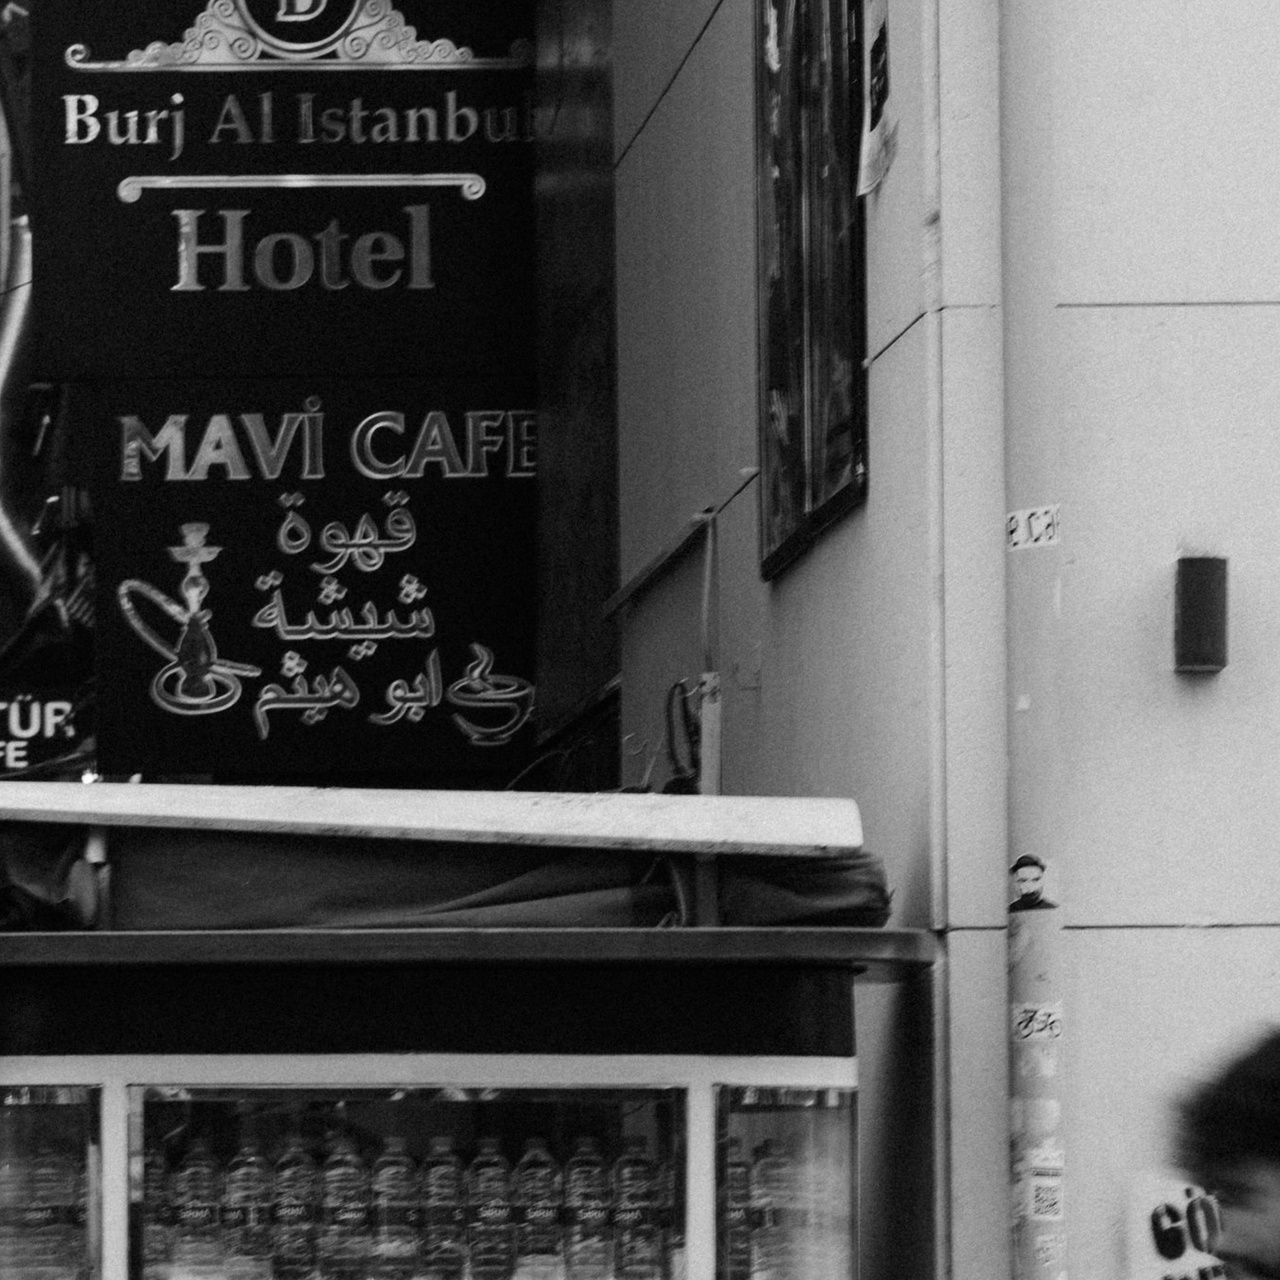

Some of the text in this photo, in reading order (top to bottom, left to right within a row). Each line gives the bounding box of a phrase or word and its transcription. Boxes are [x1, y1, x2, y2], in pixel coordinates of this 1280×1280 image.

[61, 91, 185, 161] Burj
[208, 92, 273, 144] Al
[169, 205, 434, 292] Hotel
[119, 395, 537, 482] MAVİ CAFE
[277, 490, 417, 574] قهوة
[252, 570, 437, 661] شيشة
